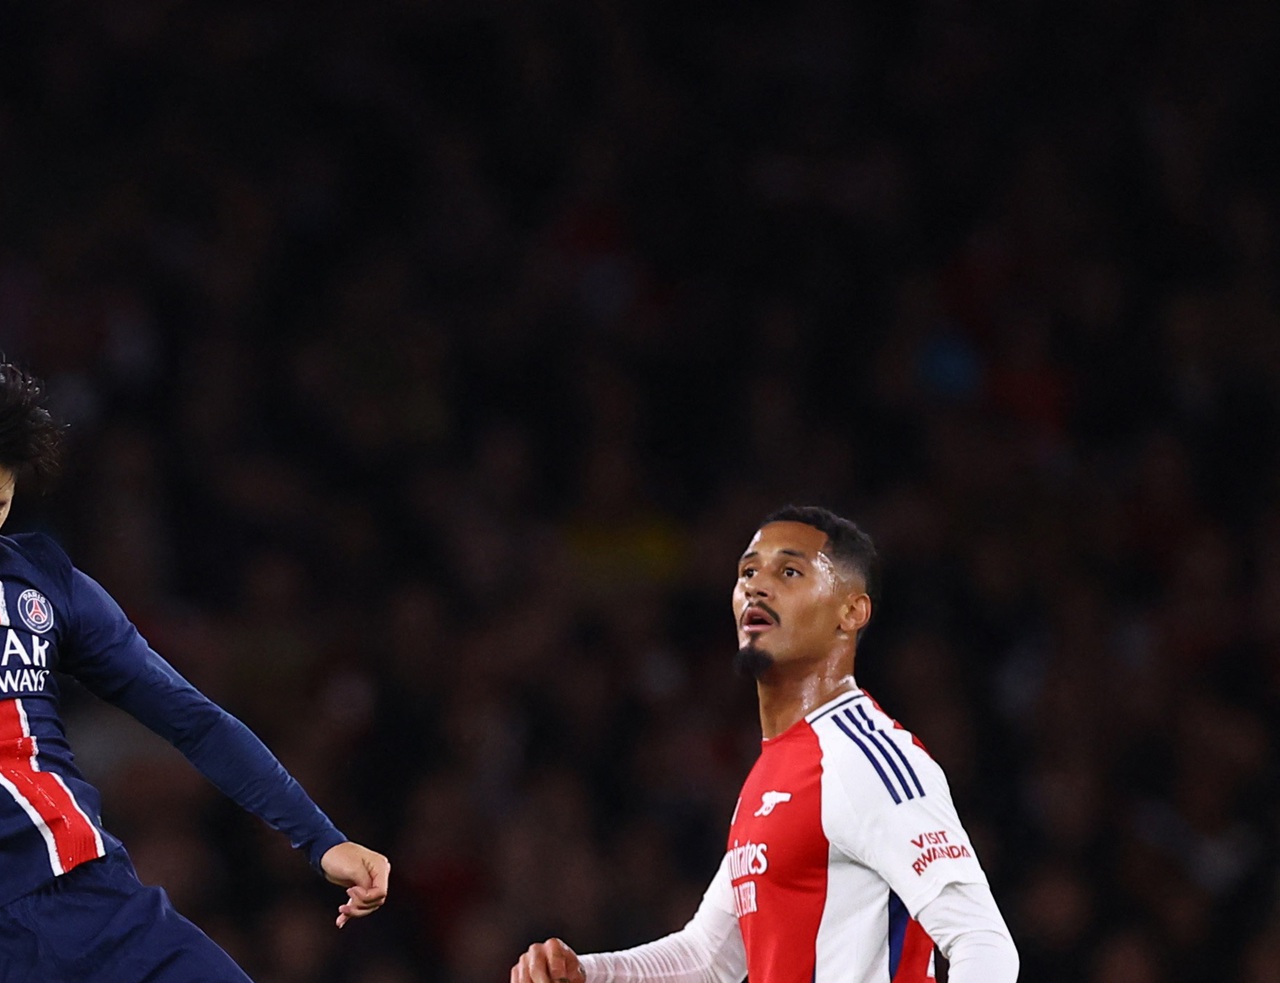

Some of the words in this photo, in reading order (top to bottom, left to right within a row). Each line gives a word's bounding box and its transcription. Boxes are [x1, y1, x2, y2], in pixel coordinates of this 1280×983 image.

[22, 591, 46, 604] PARIS
[910, 830, 949, 850] VISIT
[911, 844, 972, 877] RWANDA
